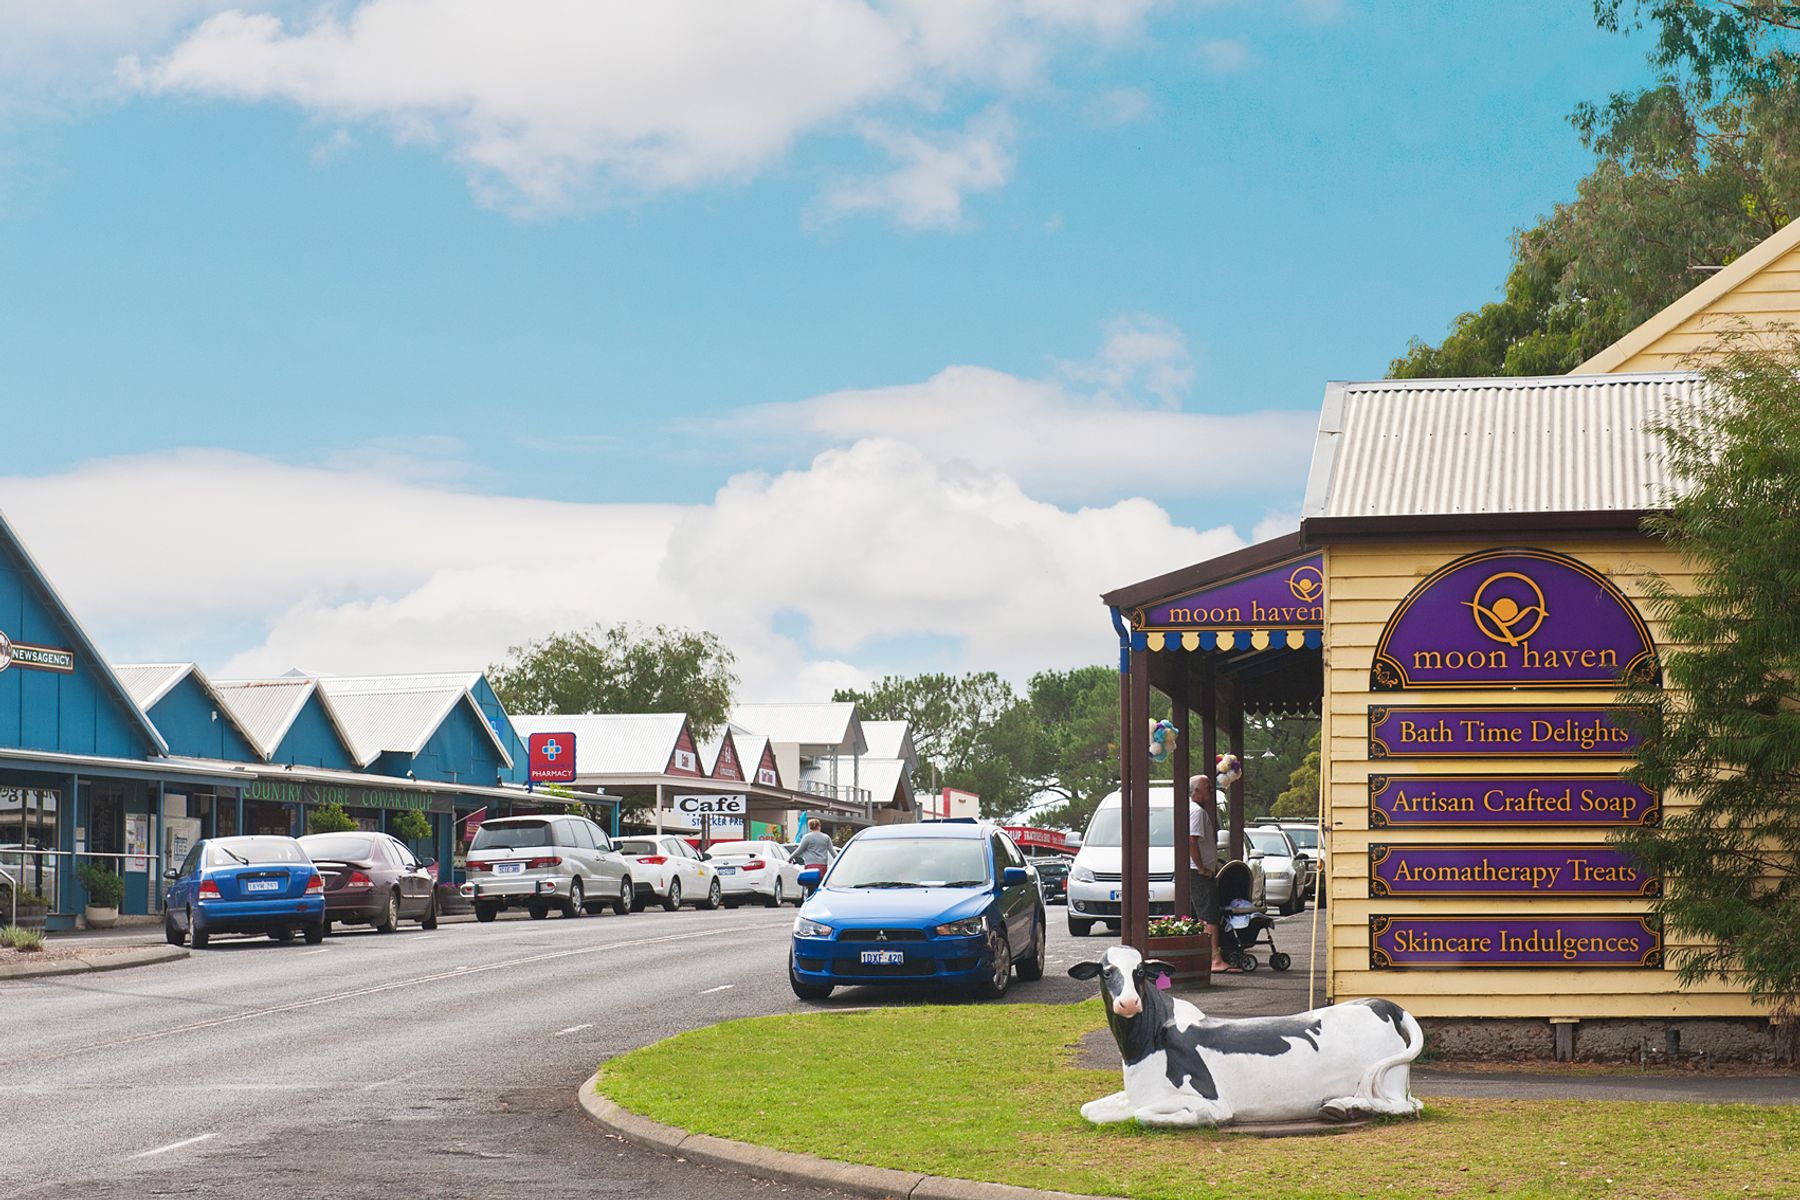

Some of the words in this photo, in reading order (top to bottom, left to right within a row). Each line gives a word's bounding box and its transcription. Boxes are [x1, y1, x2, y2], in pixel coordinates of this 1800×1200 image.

[1169, 606, 1241, 623] moon
[1251, 600, 1324, 622] haven
[12, 648, 71, 666] NEWSAGENCY
[1413, 649, 1507, 669] moon
[1522, 641, 1618, 668] haven
[1400, 720, 1453, 743] Bath
[1460, 720, 1522, 742] Time
[1531, 719, 1629, 749] Delights
[313, 785, 350, 806] STORE
[362, 790, 433, 811] COWARAMUP
[679, 796, 740, 812] Café
[1391, 790, 1475, 812] Artisan
[1483, 788, 1572, 812] Crafted
[1580, 789, 1637, 818] Soap
[1393, 858, 1561, 888] Aromatherapy
[1567, 859, 1637, 882] Treats
[1393, 929, 1491, 953] Skincare
[1499, 930, 1639, 959] Indulgences
